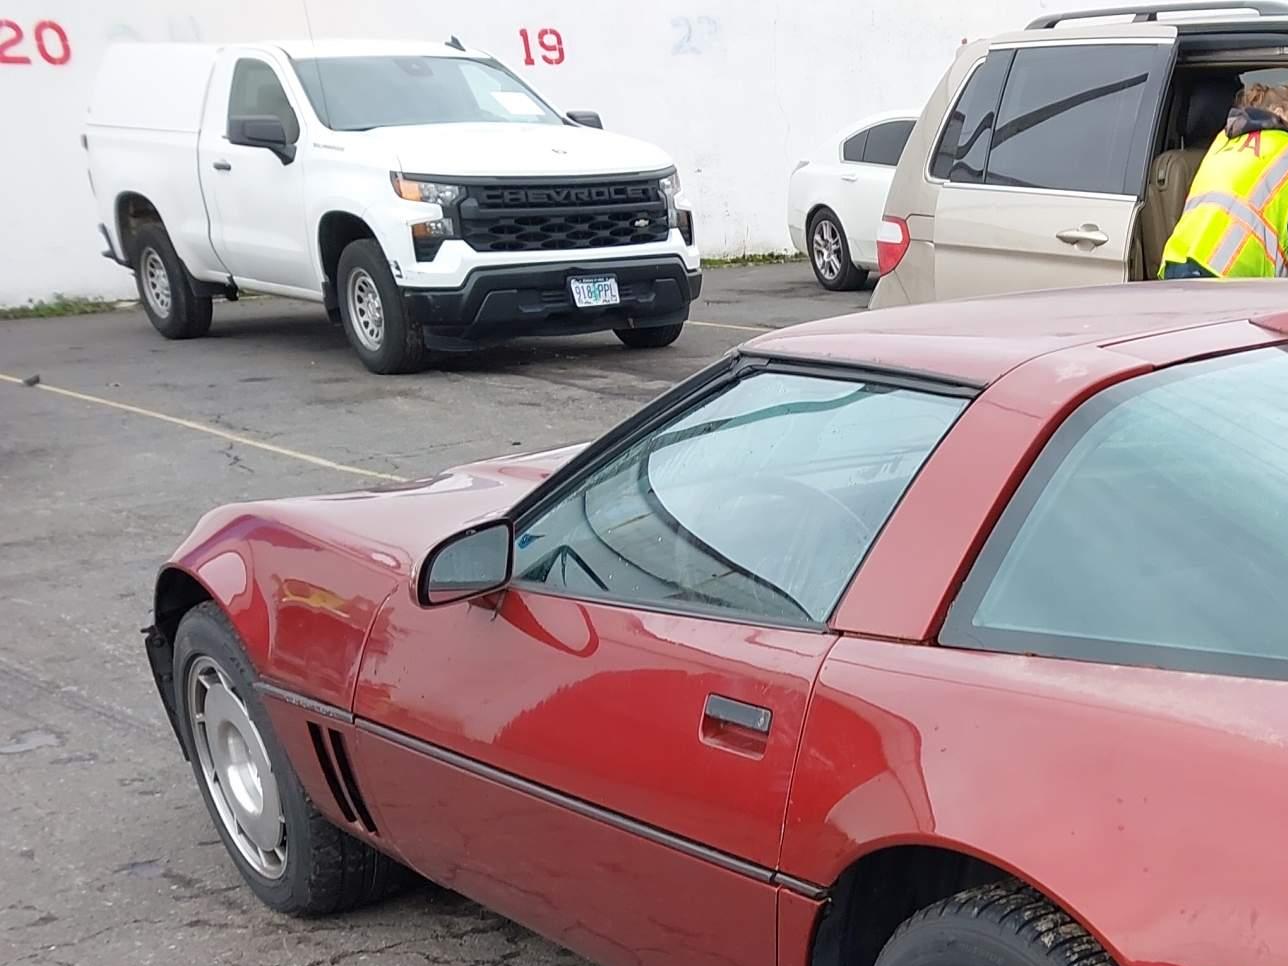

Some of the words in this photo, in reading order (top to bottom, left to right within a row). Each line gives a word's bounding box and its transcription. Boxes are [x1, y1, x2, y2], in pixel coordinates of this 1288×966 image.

[0, 20, 71, 65] 20
[519, 28, 565, 66] 19
[485, 184, 659, 204] CHEVROLET
[574, 284, 593, 299] 918
[597, 283, 617, 299] PPL
